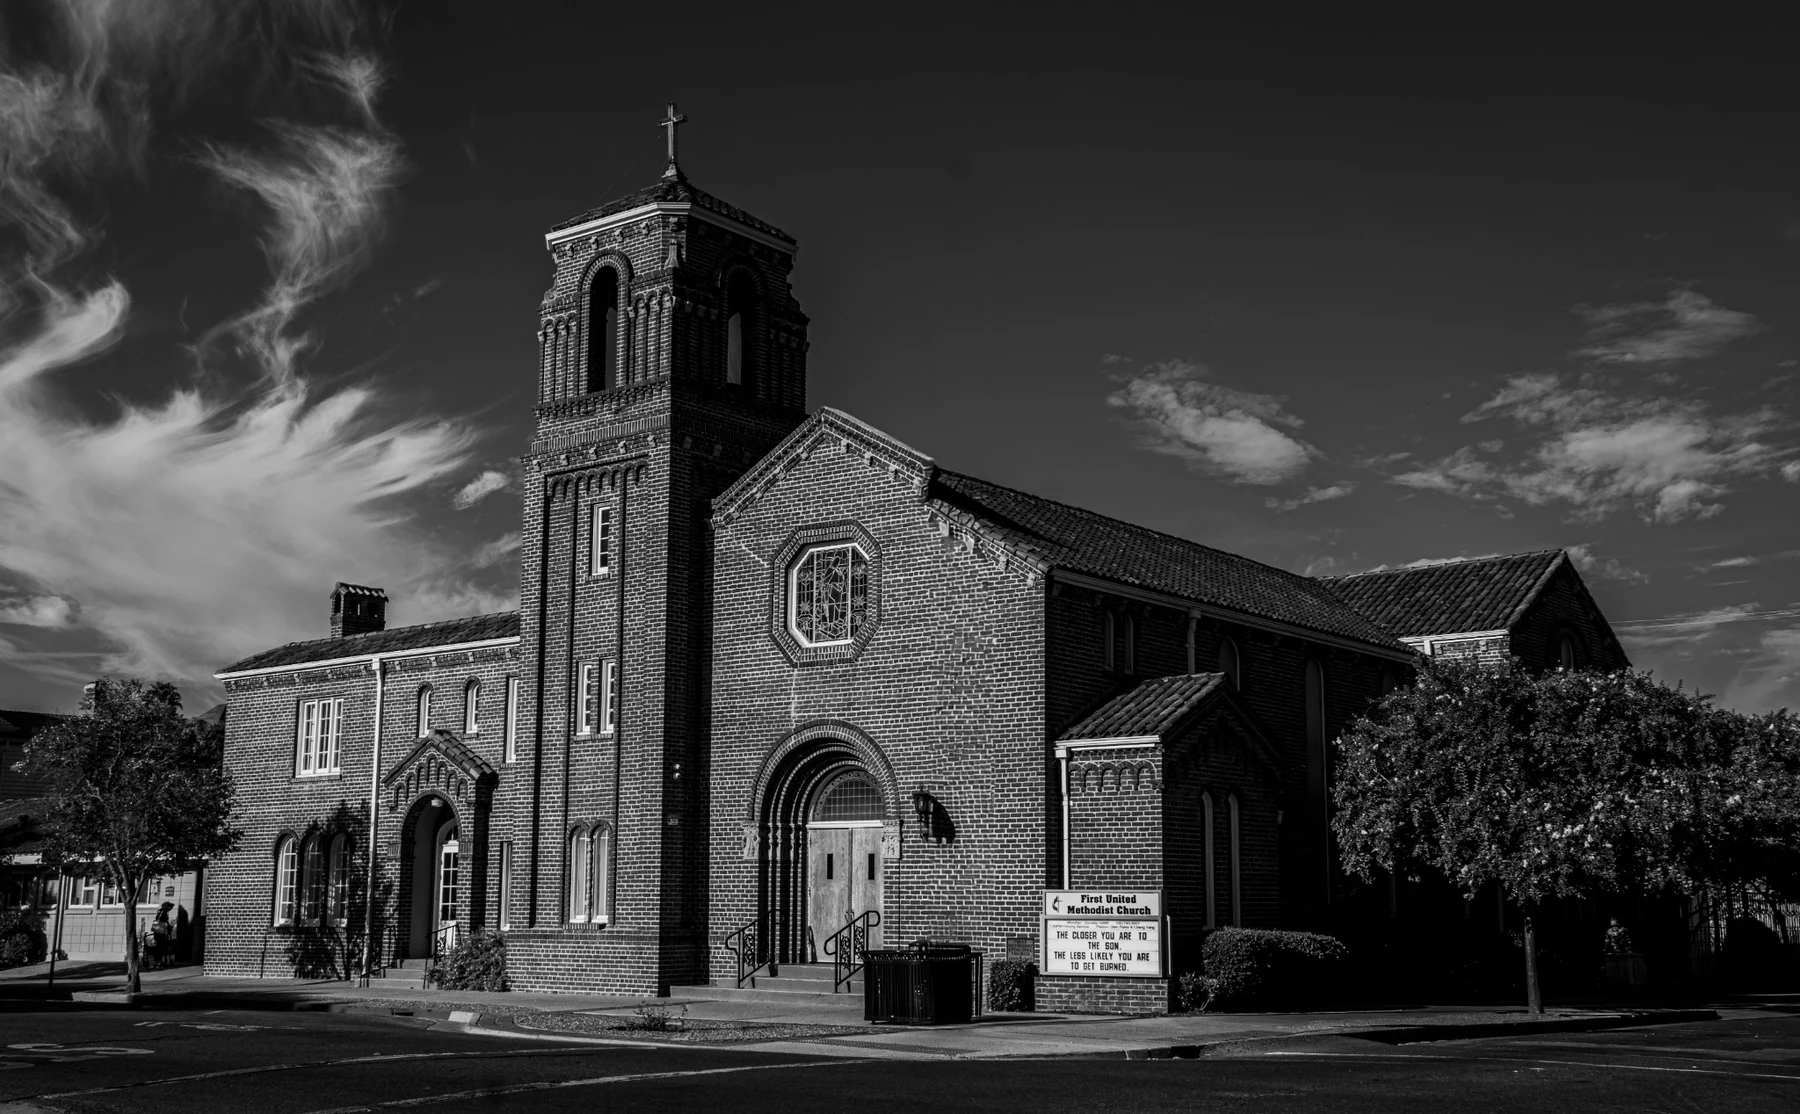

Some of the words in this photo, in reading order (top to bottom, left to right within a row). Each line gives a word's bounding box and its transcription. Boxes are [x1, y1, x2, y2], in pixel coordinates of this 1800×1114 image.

[1080, 894, 1103, 903] First
[1106, 894, 1137, 904] United
[1067, 905, 1114, 915] Methodist
[1116, 905, 1152, 915] Church
[1056, 931, 1069, 939] THE
[1072, 931, 1098, 940] CLOSER
[1101, 931, 1115, 940] YOU
[1119, 931, 1132, 940] ARE
[1138, 931, 1148, 940] TO
[1088, 941, 1100, 950] THE
[1054, 951, 1066, 959] THE
[1069, 951, 1086, 960] LESS
[1090, 952, 1114, 960] LIKELY
[1117, 952, 1132, 961] YOU
[1136, 952, 1150, 961] ARE
[1070, 961, 1080, 970] TO
[1083, 962, 1095, 970] GET
[1099, 962, 1130, 971] BURNED.
